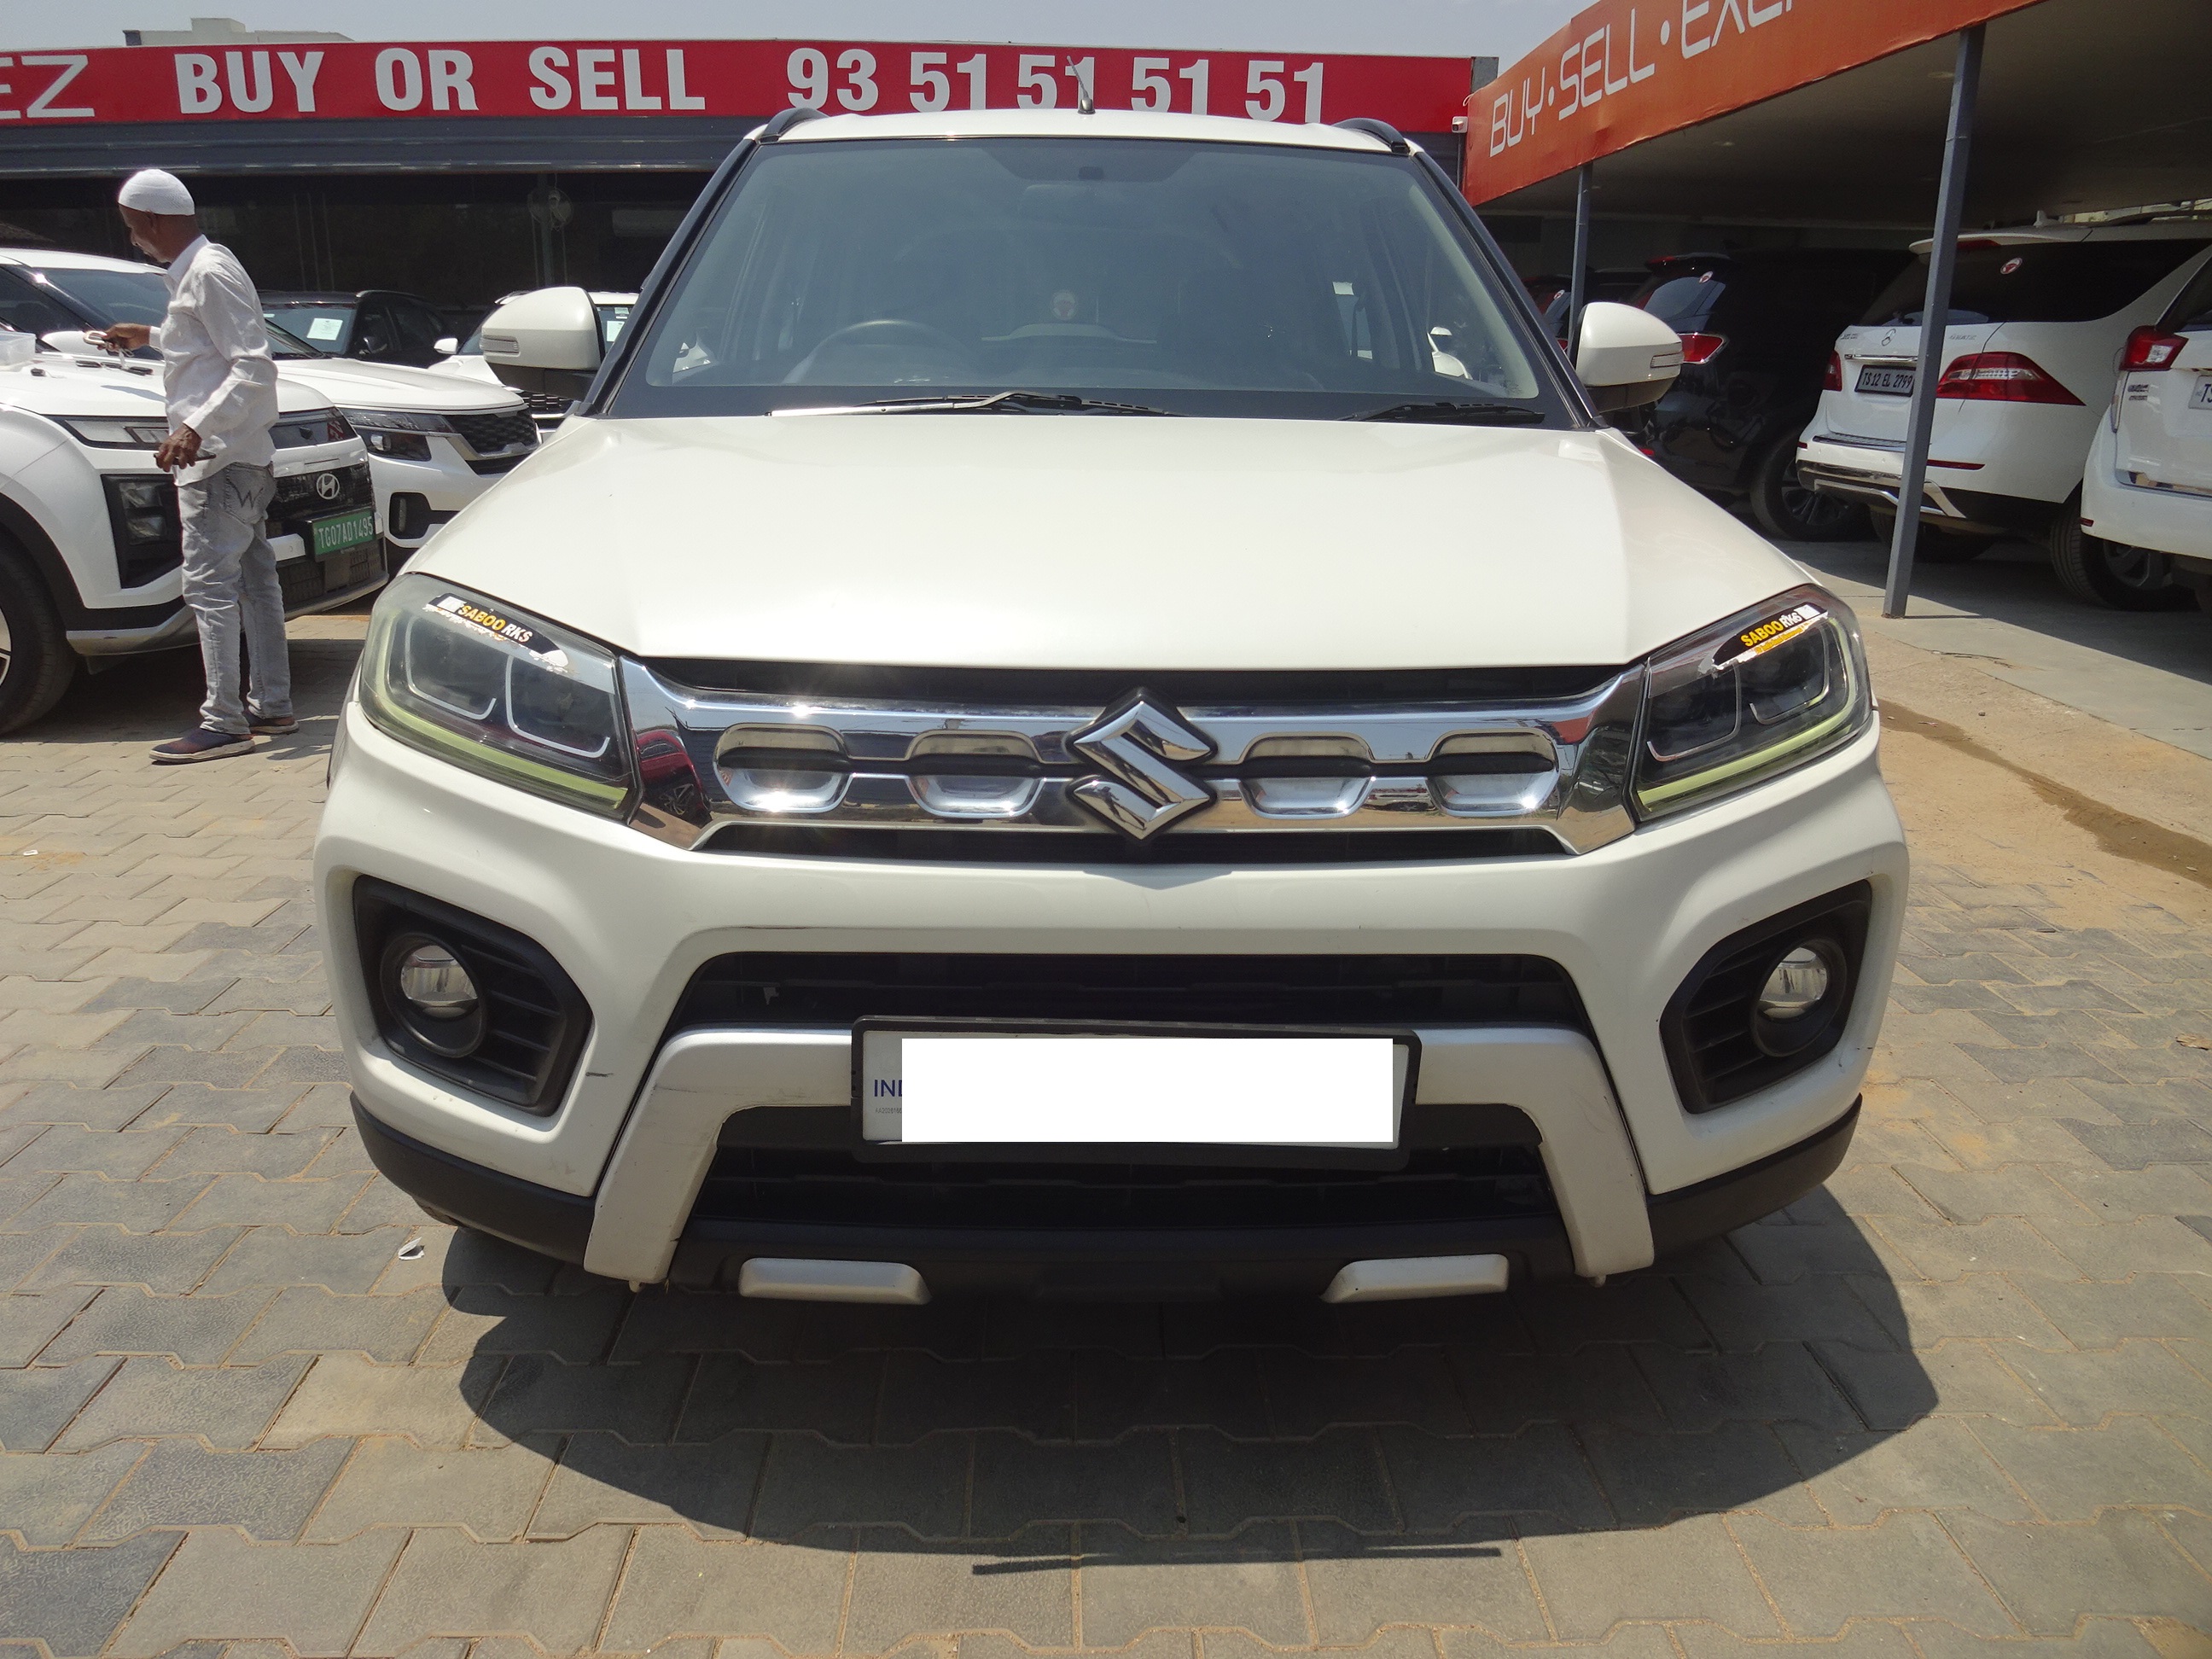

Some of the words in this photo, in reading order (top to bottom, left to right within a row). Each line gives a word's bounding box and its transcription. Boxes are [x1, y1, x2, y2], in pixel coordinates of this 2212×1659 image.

[174, 50, 325, 114] BUY
[375, 47, 480, 112] OR
[529, 46, 706, 111] SELL
[787, 47, 879, 112] 93
[909, 51, 987, 113] 51
[1017, 54, 1095, 110] 51
[1132, 56, 1208, 114] 51
[1245, 60, 1324, 124] 51
[1489, 67, 1545, 158] BUY
[1558, 8, 1656, 121] SELL
[457, 604, 506, 631] SABOO
[501, 623, 533, 643] RKS
[1741, 620, 1784, 647] SABOO
